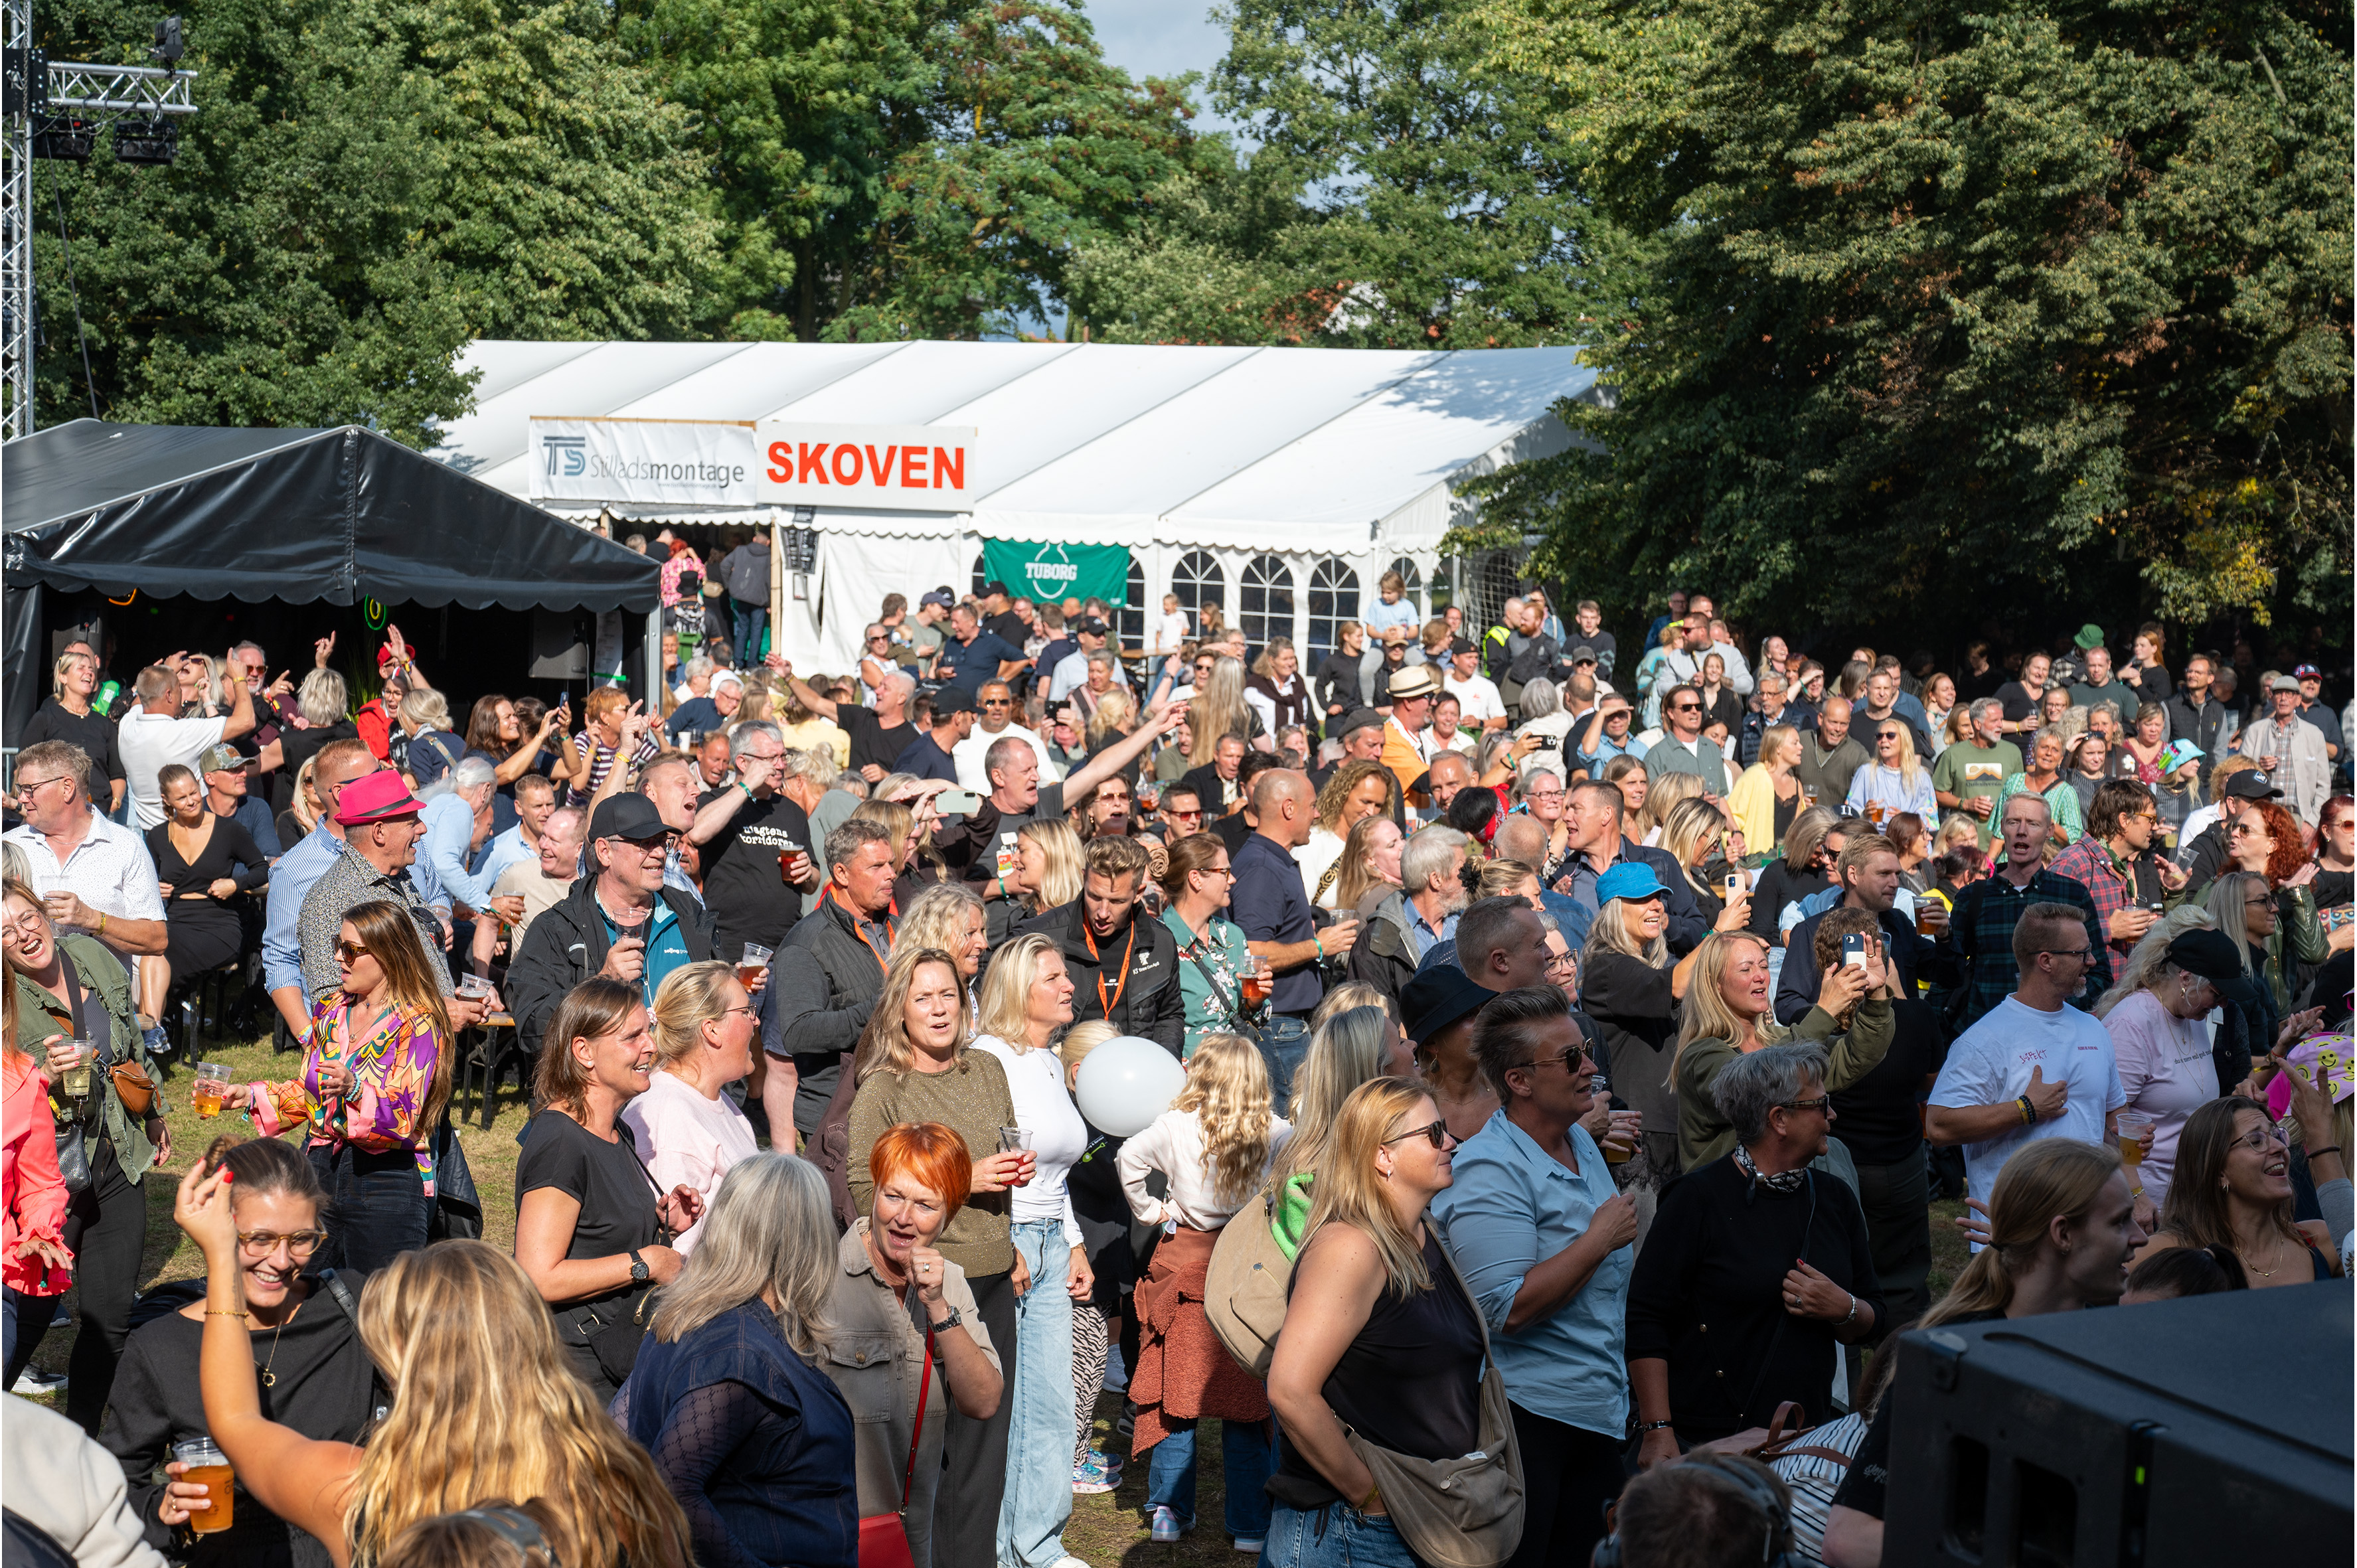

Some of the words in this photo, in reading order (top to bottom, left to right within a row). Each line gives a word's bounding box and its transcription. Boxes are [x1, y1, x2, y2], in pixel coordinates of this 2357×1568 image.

[543, 436, 586, 476] TS
[590, 454, 744, 489] Stilladsmontage
[767, 441, 964, 489] SKOVEN
[1024, 562, 1078, 582] TUBORG
[2019, 1049, 2047, 1064] SUSPEKT
